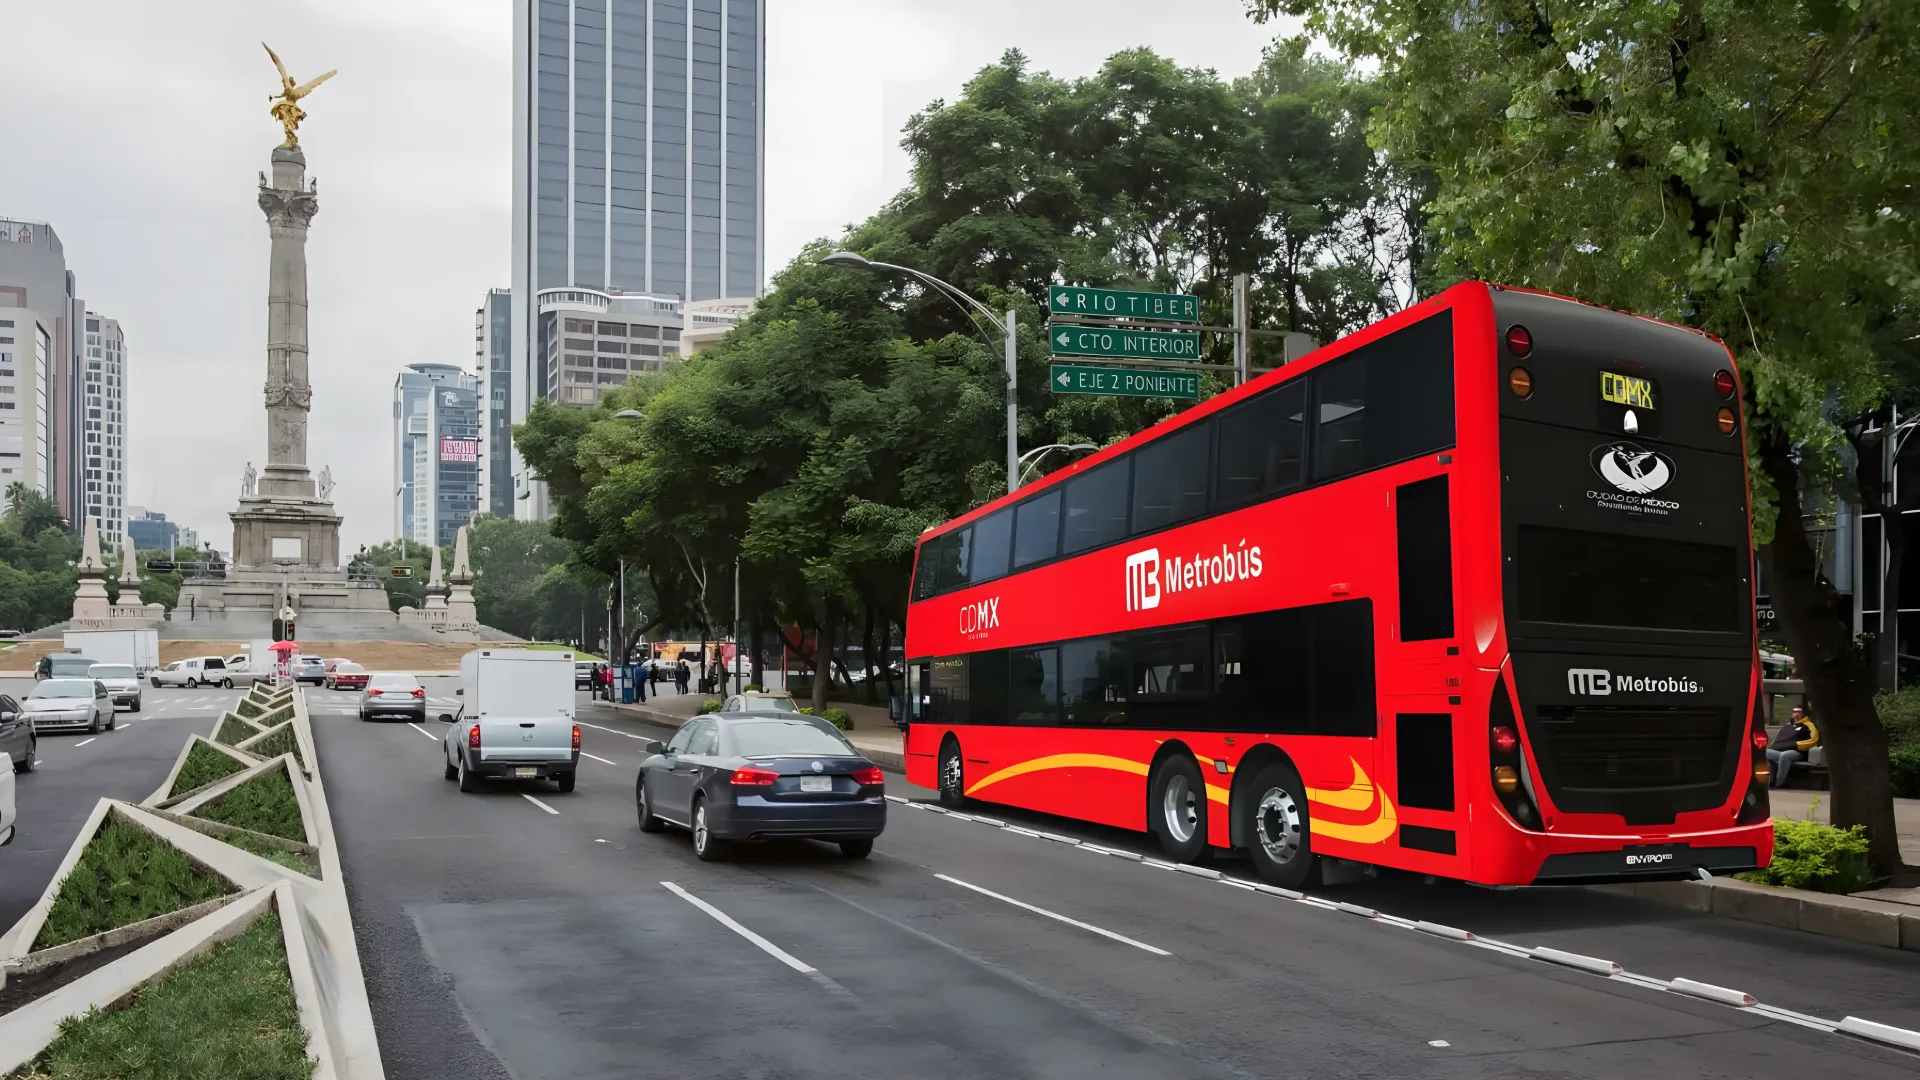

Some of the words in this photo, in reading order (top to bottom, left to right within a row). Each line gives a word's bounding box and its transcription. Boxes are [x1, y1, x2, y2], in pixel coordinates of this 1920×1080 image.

[1077, 293, 1116, 311] RIO
[1127, 296, 1194, 316] TIBER
[1124, 336, 1194, 354] INTERIOR
[1079, 372, 1105, 389] EJE
[1111, 374, 1119, 390] 2
[1126, 375, 1195, 393] PONIENTE
[1601, 372, 1654, 408] CDMX
[1165, 538, 1263, 594] Metrobús
[960, 596, 1000, 634] CDMX
[1616, 675, 1698, 693] Metrobús
